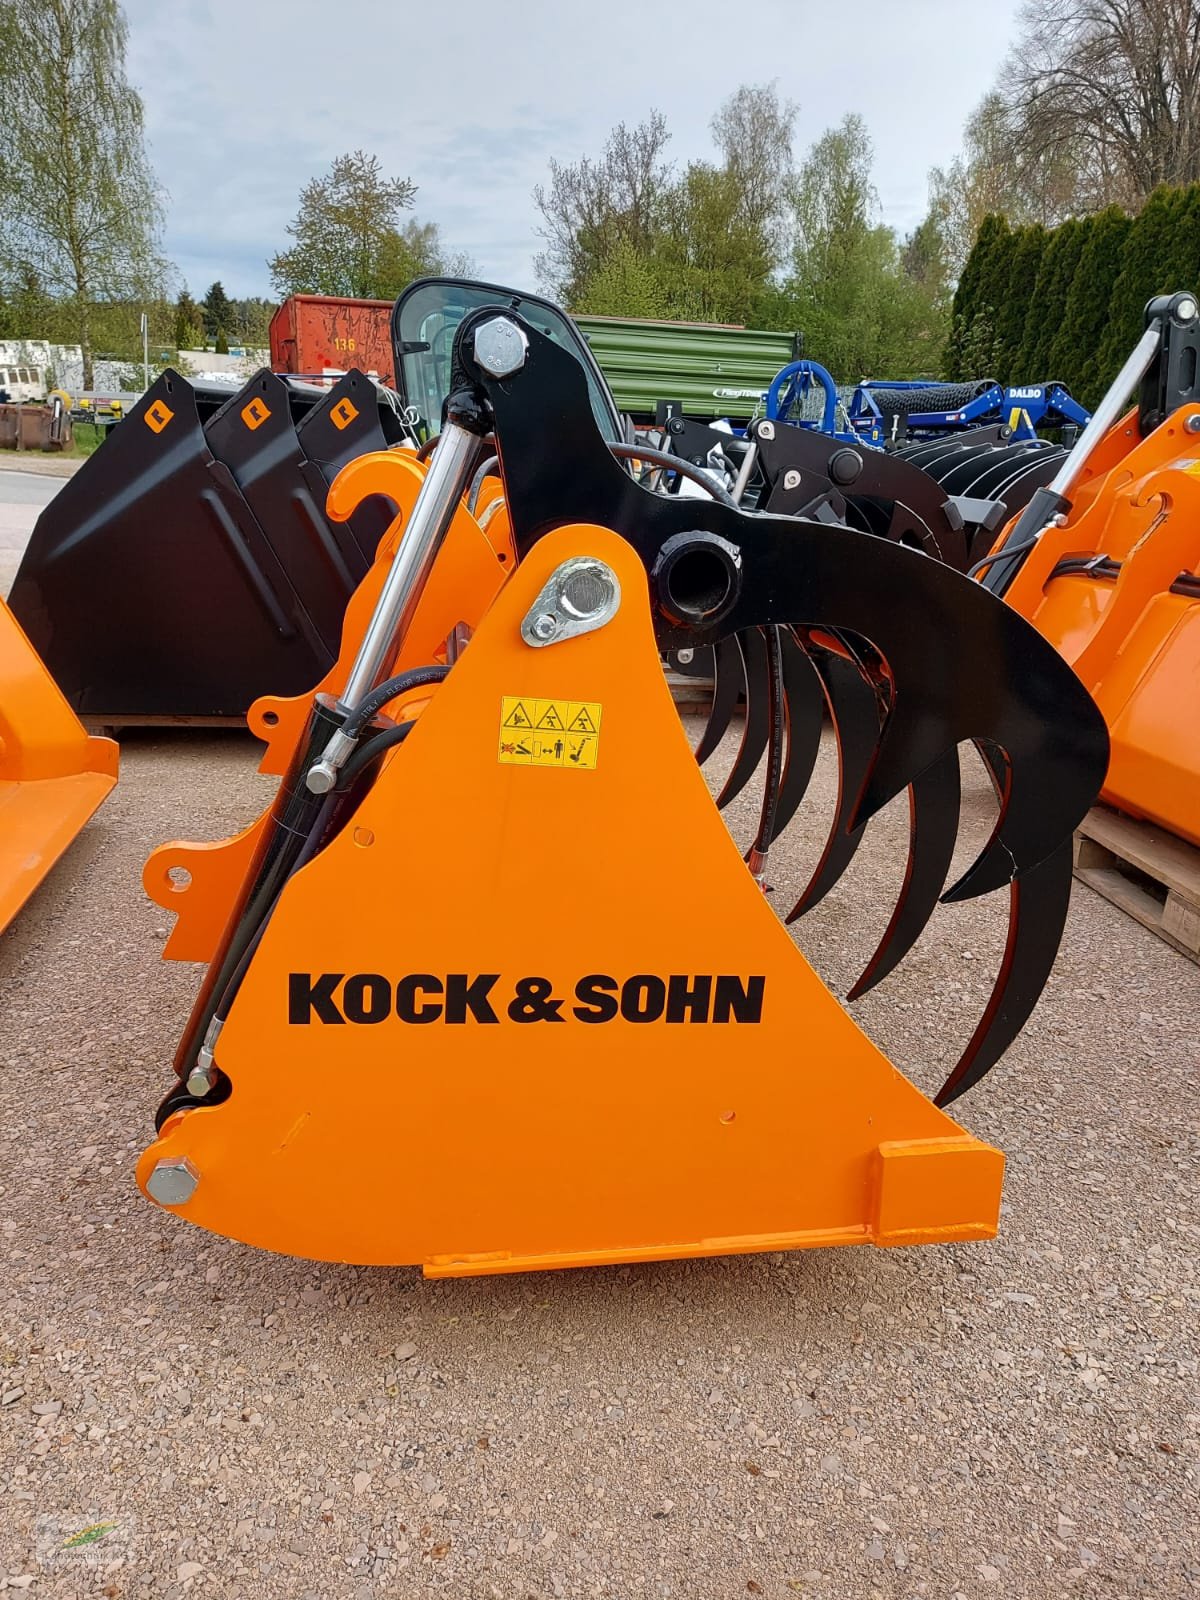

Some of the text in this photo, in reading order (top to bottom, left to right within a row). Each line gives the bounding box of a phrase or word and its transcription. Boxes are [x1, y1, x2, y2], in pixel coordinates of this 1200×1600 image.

[334, 338, 356, 351] 136
[1009, 388, 1042, 398] DALBO
[288, 973, 766, 1024] KOCK & SOHN
